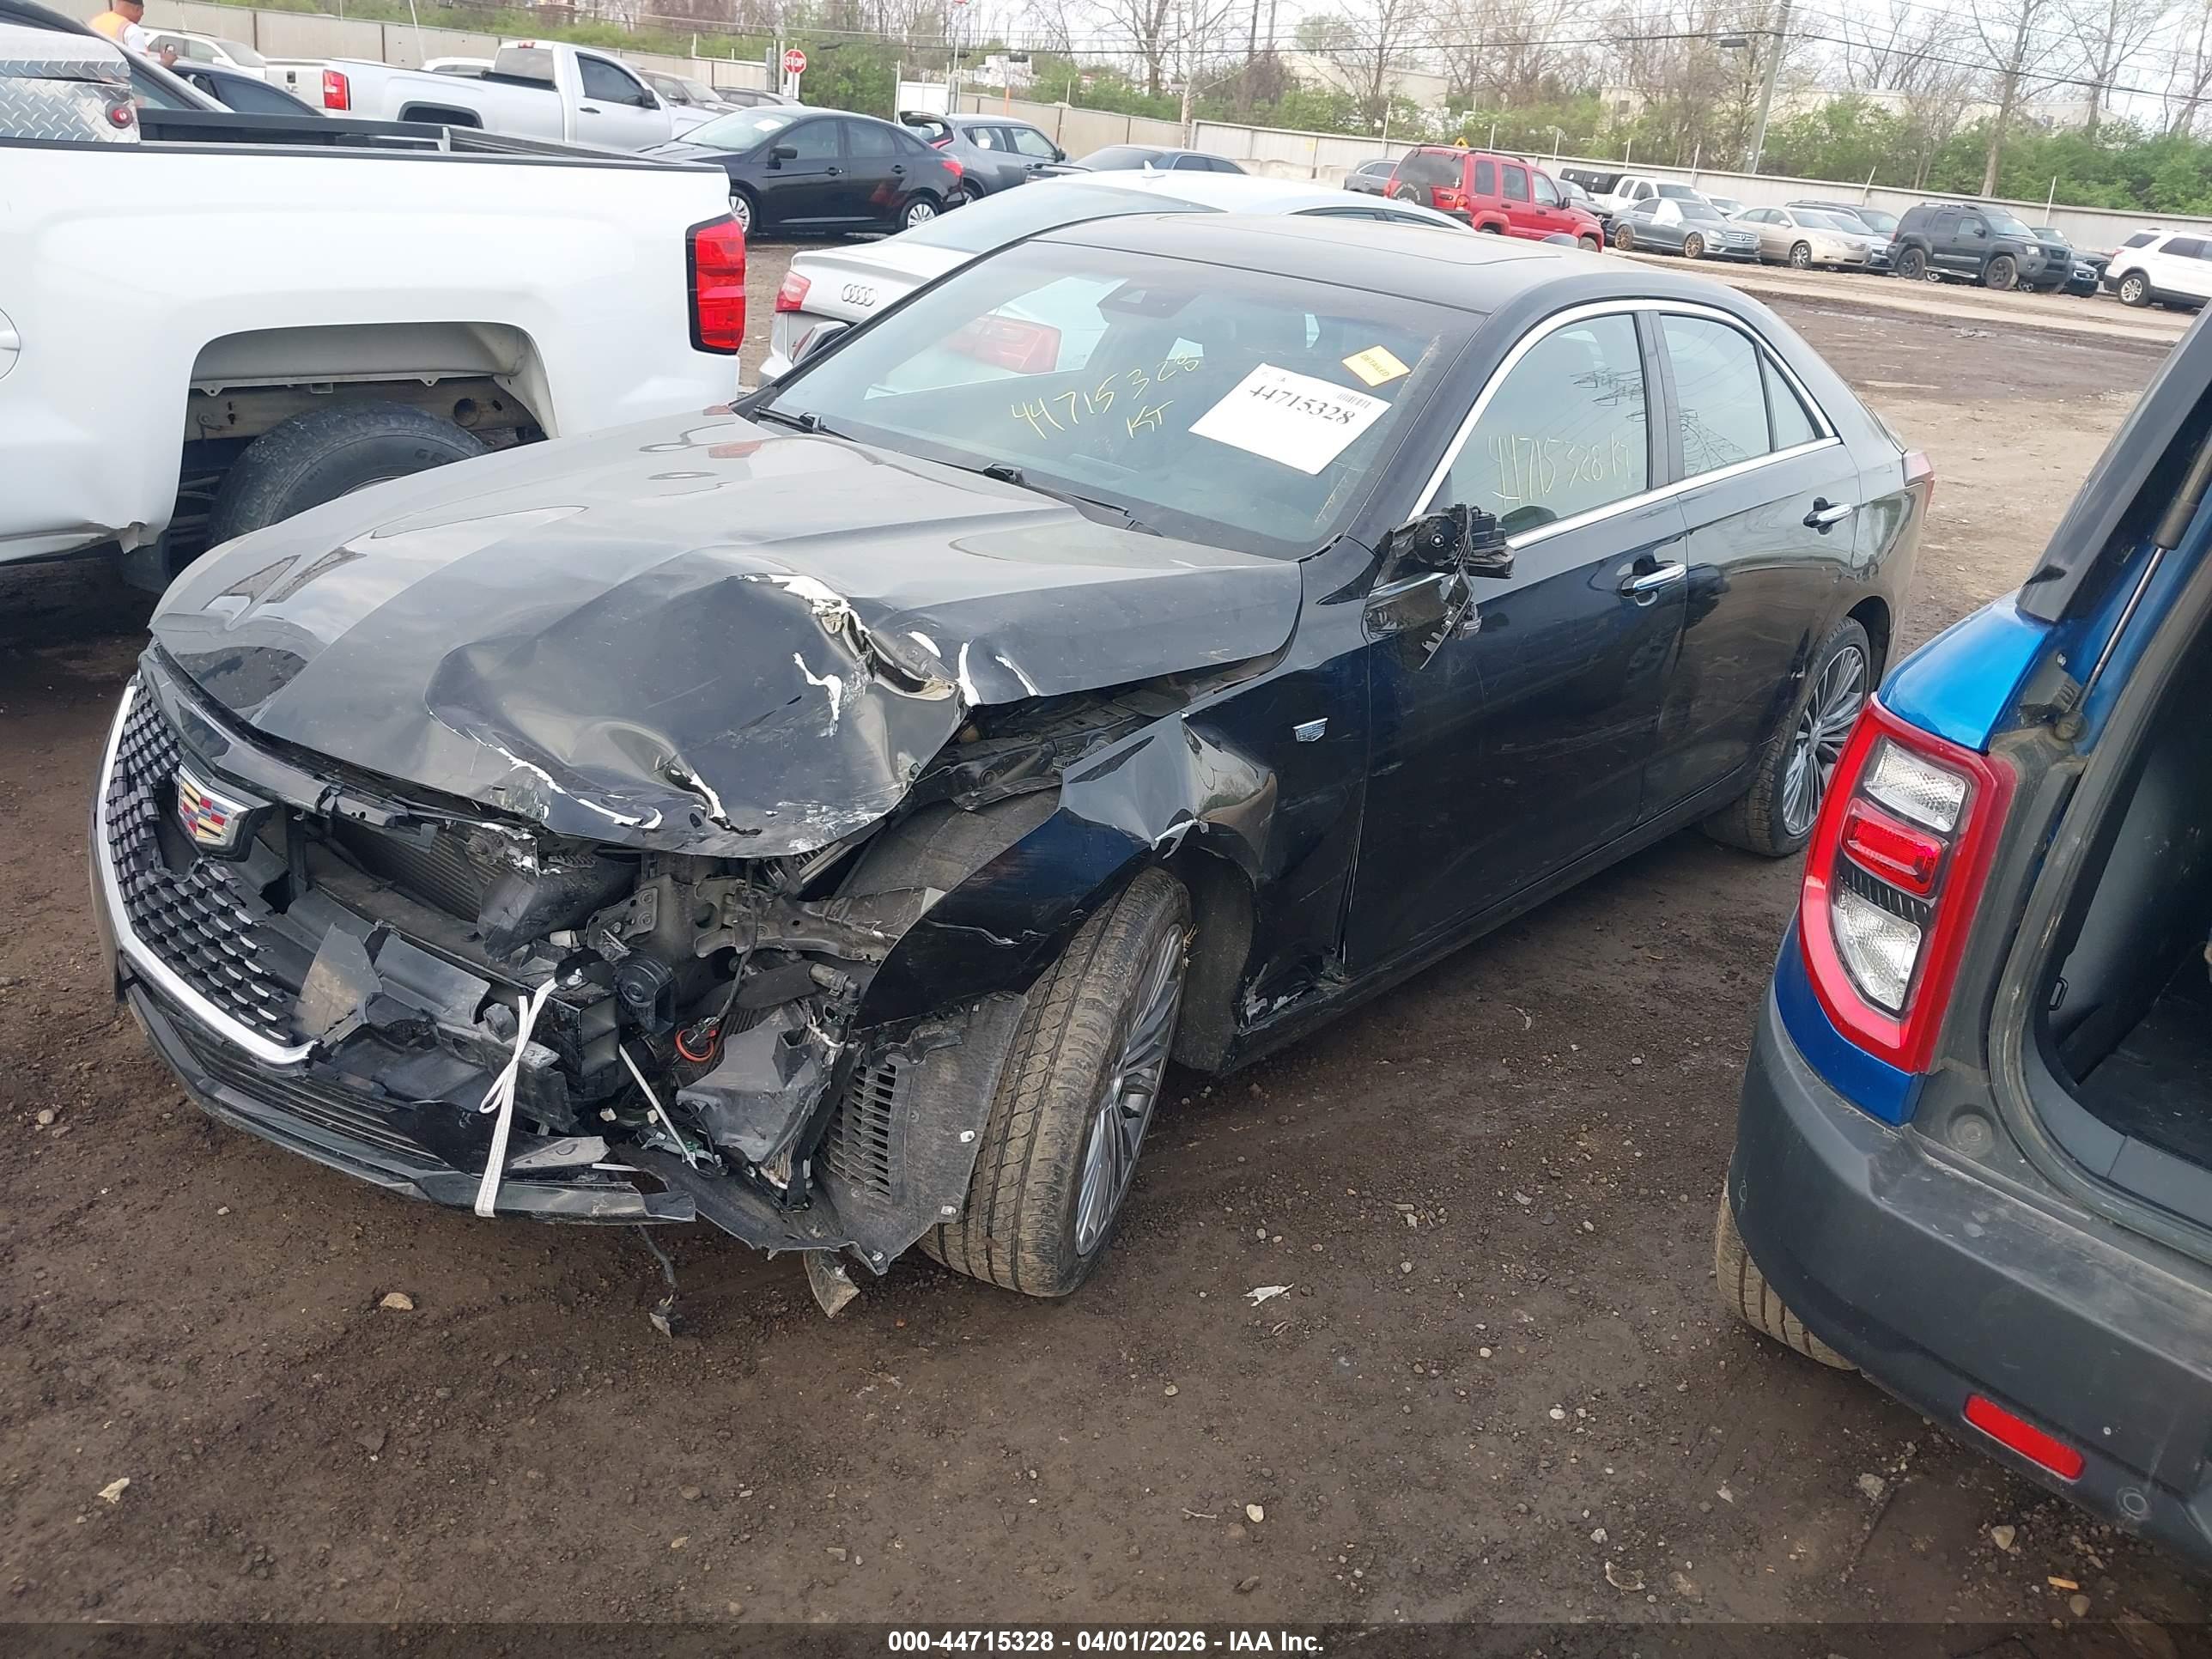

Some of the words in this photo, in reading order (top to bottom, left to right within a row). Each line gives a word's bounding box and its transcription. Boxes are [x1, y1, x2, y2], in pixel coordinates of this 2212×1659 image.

[785, 56, 805, 67] STOP
[1359, 354, 1390, 377] DETAILED
[1126, 400, 1175, 440] KT
[1249, 385, 1356, 425] 44715328
